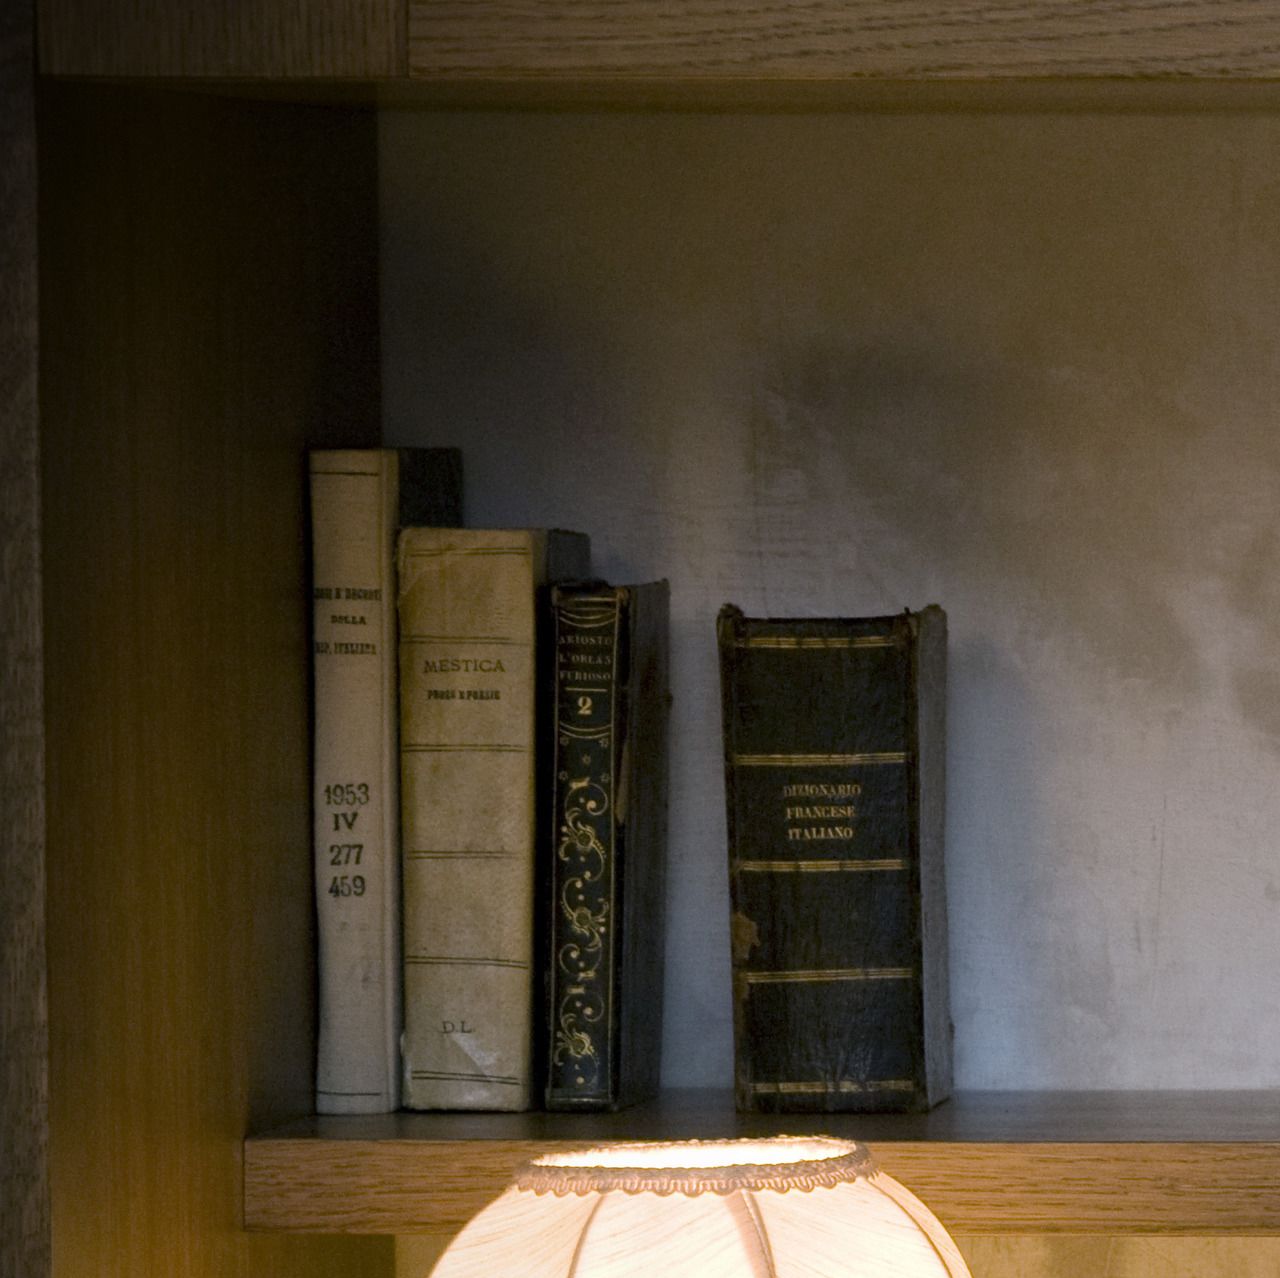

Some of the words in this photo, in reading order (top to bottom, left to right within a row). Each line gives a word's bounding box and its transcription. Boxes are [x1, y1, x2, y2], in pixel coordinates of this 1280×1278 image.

[559, 635, 613, 646] ARIOSTO
[423, 659, 506, 673] MESTICA
[559, 670, 612, 681] FURIOSO
[577, 695, 593, 716] 2
[324, 783, 370, 806] 1953
[783, 783, 862, 798] DIZIONARIO
[786, 805, 857, 820] FRANCESE
[333, 813, 359, 832] IV
[787, 826, 854, 840] ITALIANO
[329, 845, 364, 867] 277
[328, 876, 366, 898] 459
